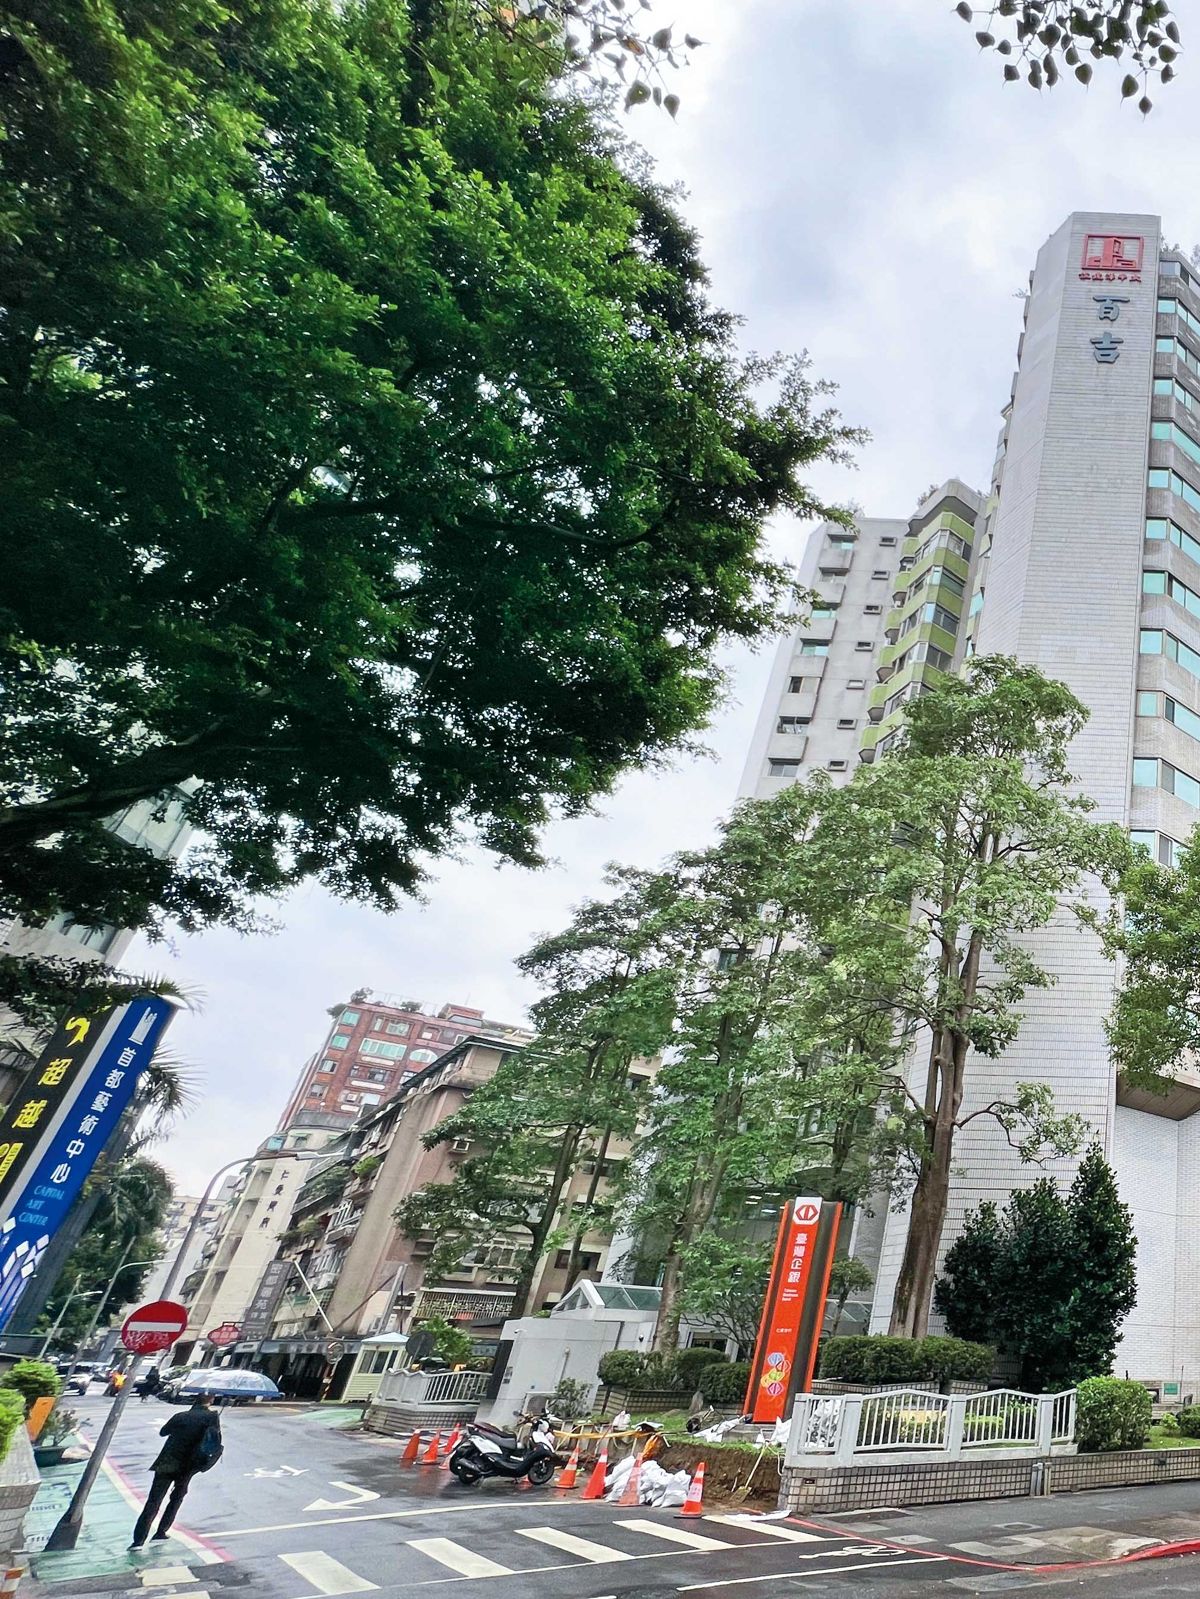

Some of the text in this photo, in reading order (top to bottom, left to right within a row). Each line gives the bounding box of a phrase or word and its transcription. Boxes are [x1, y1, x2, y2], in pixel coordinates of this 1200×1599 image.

[12, 1058, 73, 1129] 超越
[50, 1047, 137, 1184] 首都藝術中心
[34, 1185, 65, 1200] CAPITAL
[26, 1198, 45, 1210] ART
[19, 1211, 48, 1226] CENTER
